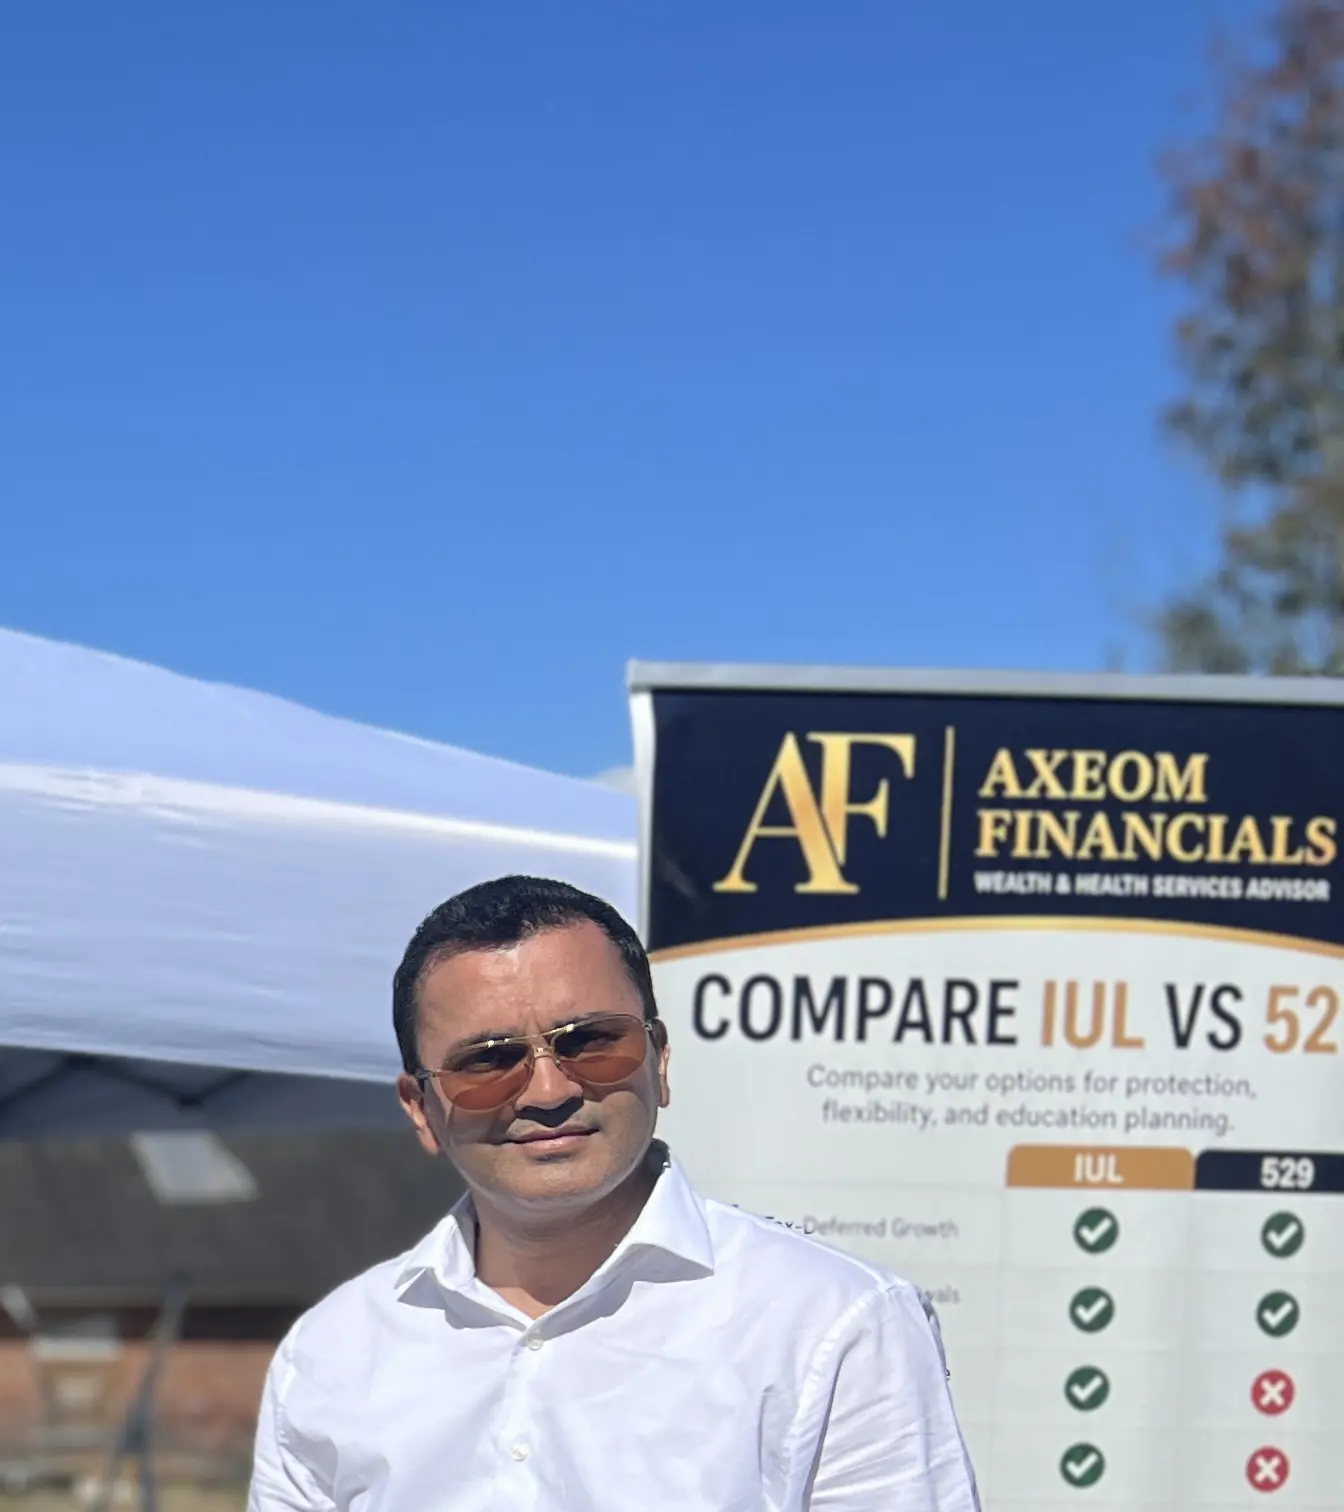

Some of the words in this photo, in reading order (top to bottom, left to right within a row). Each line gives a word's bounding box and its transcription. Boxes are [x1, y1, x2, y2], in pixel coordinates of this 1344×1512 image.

[980, 749, 1206, 801] AXEOM
[714, 734, 914, 892] AF
[977, 810, 1334, 864] FINANCIALS
[694, 974, 1018, 1044] COMPARE
[1042, 981, 1144, 1048] IUL
[1166, 985, 1242, 1050] VS
[1264, 986, 1338, 1052] 52
[807, 1064, 918, 1092] Compare
[926, 1074, 978, 1094] your
[985, 1072, 1076, 1095] options
[1084, 1071, 1118, 1092] for
[1126, 1076, 1256, 1099] protection,
[1076, 1156, 1121, 1182] IUL
[1262, 1159, 1314, 1186] 529
